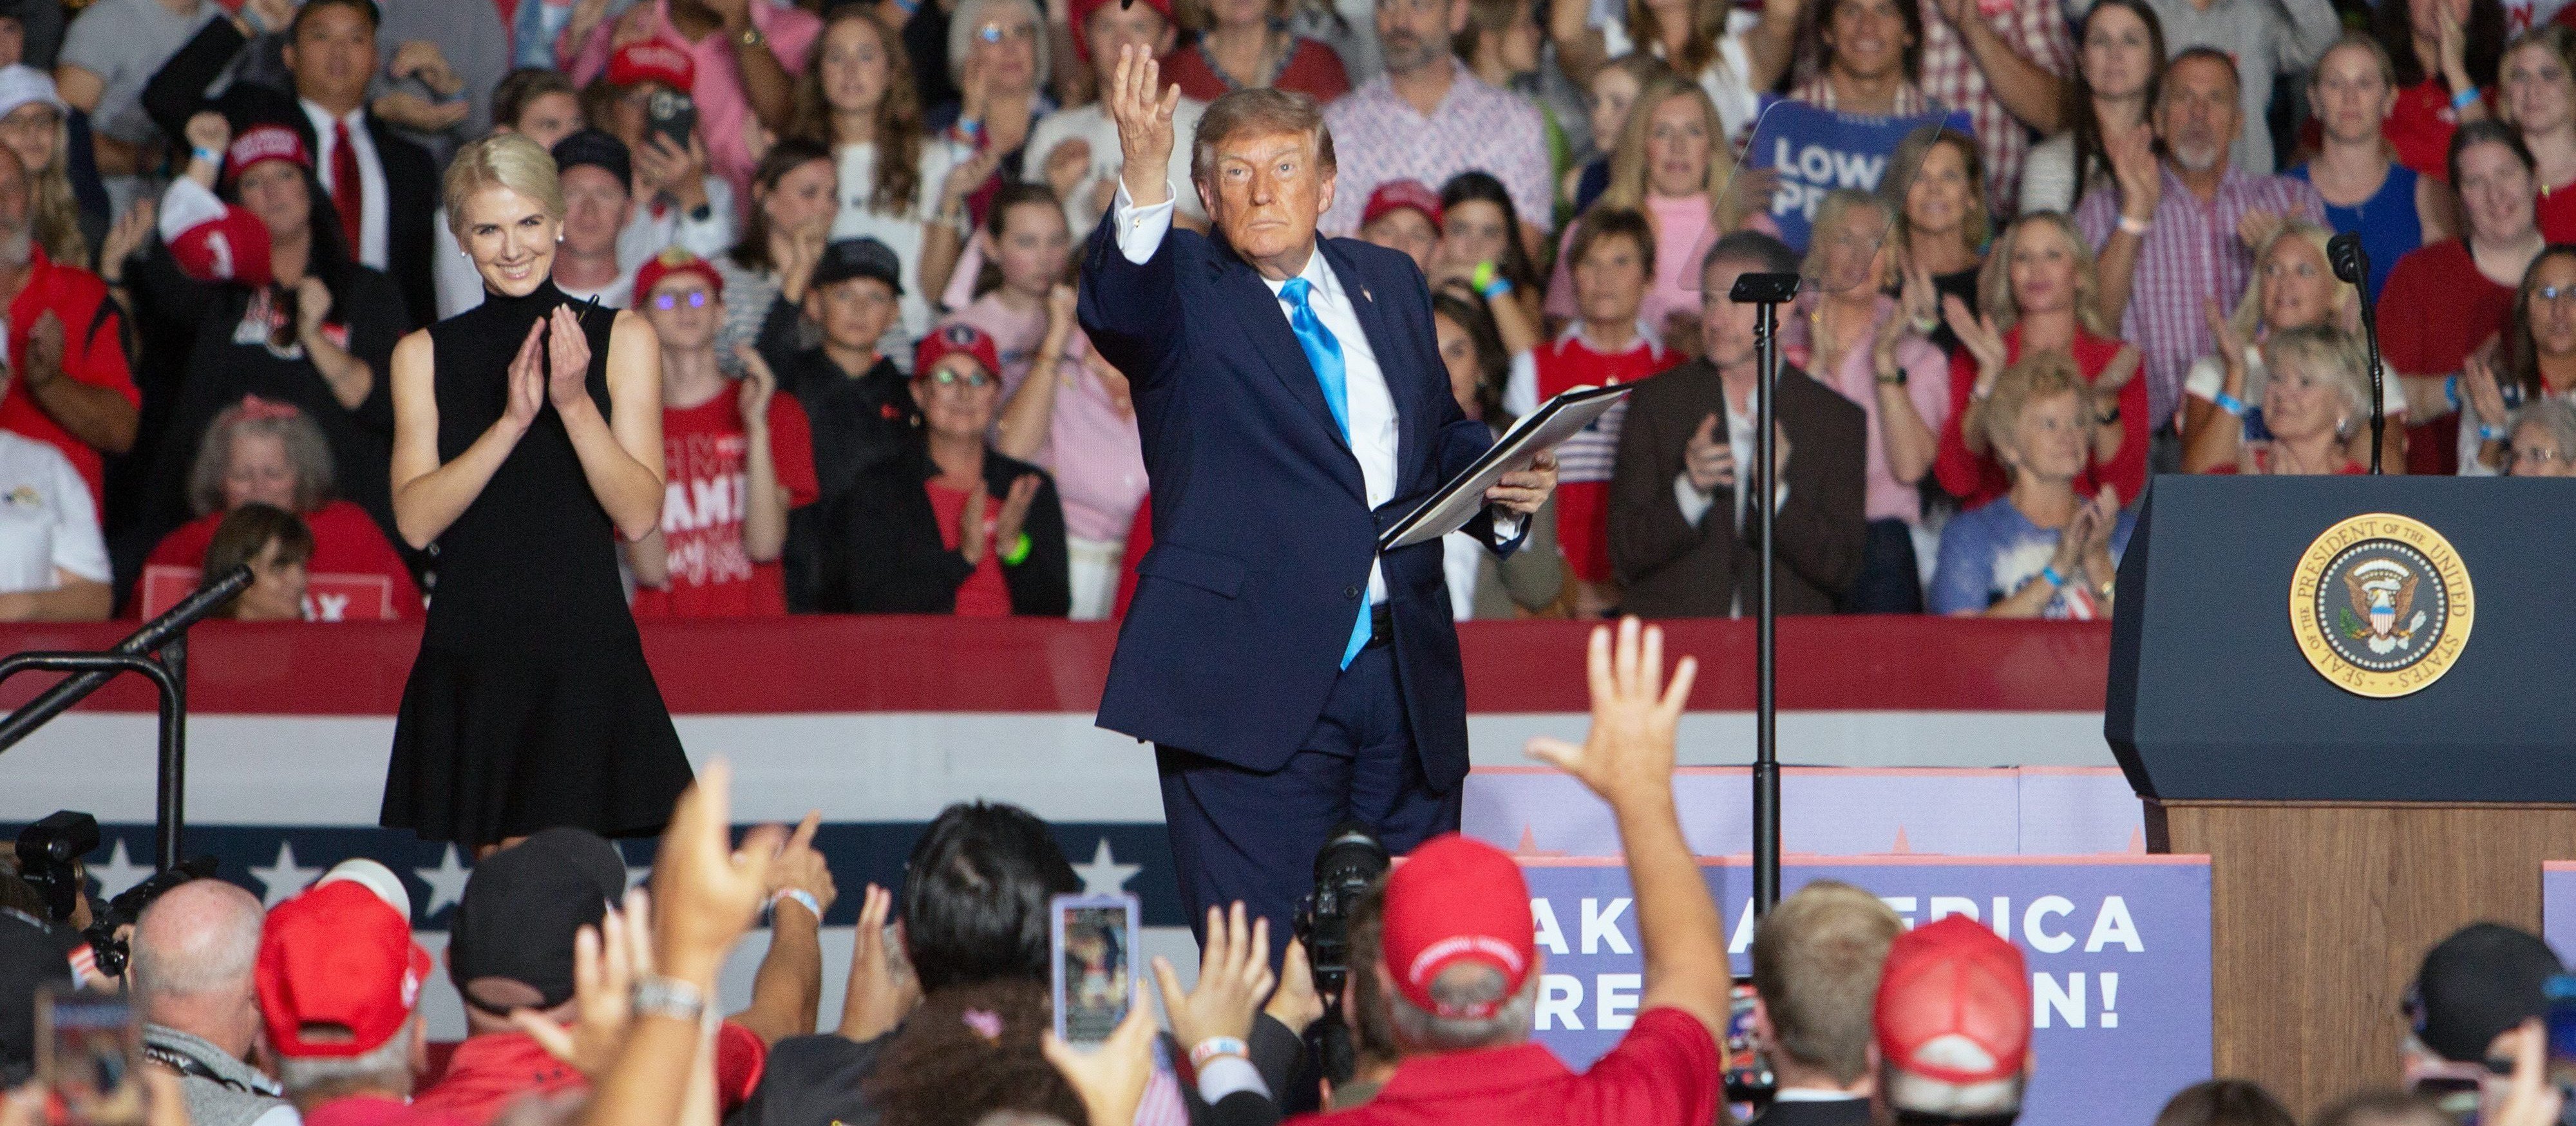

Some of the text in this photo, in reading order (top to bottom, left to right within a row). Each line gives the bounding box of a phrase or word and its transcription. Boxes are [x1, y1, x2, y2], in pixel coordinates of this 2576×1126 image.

[1775, 136, 1888, 192] LOW
[2297, 521, 2468, 688] SEAL OF THE PRESIDENT OF THE UNITED STATES
[1530, 897, 1634, 955] AK
